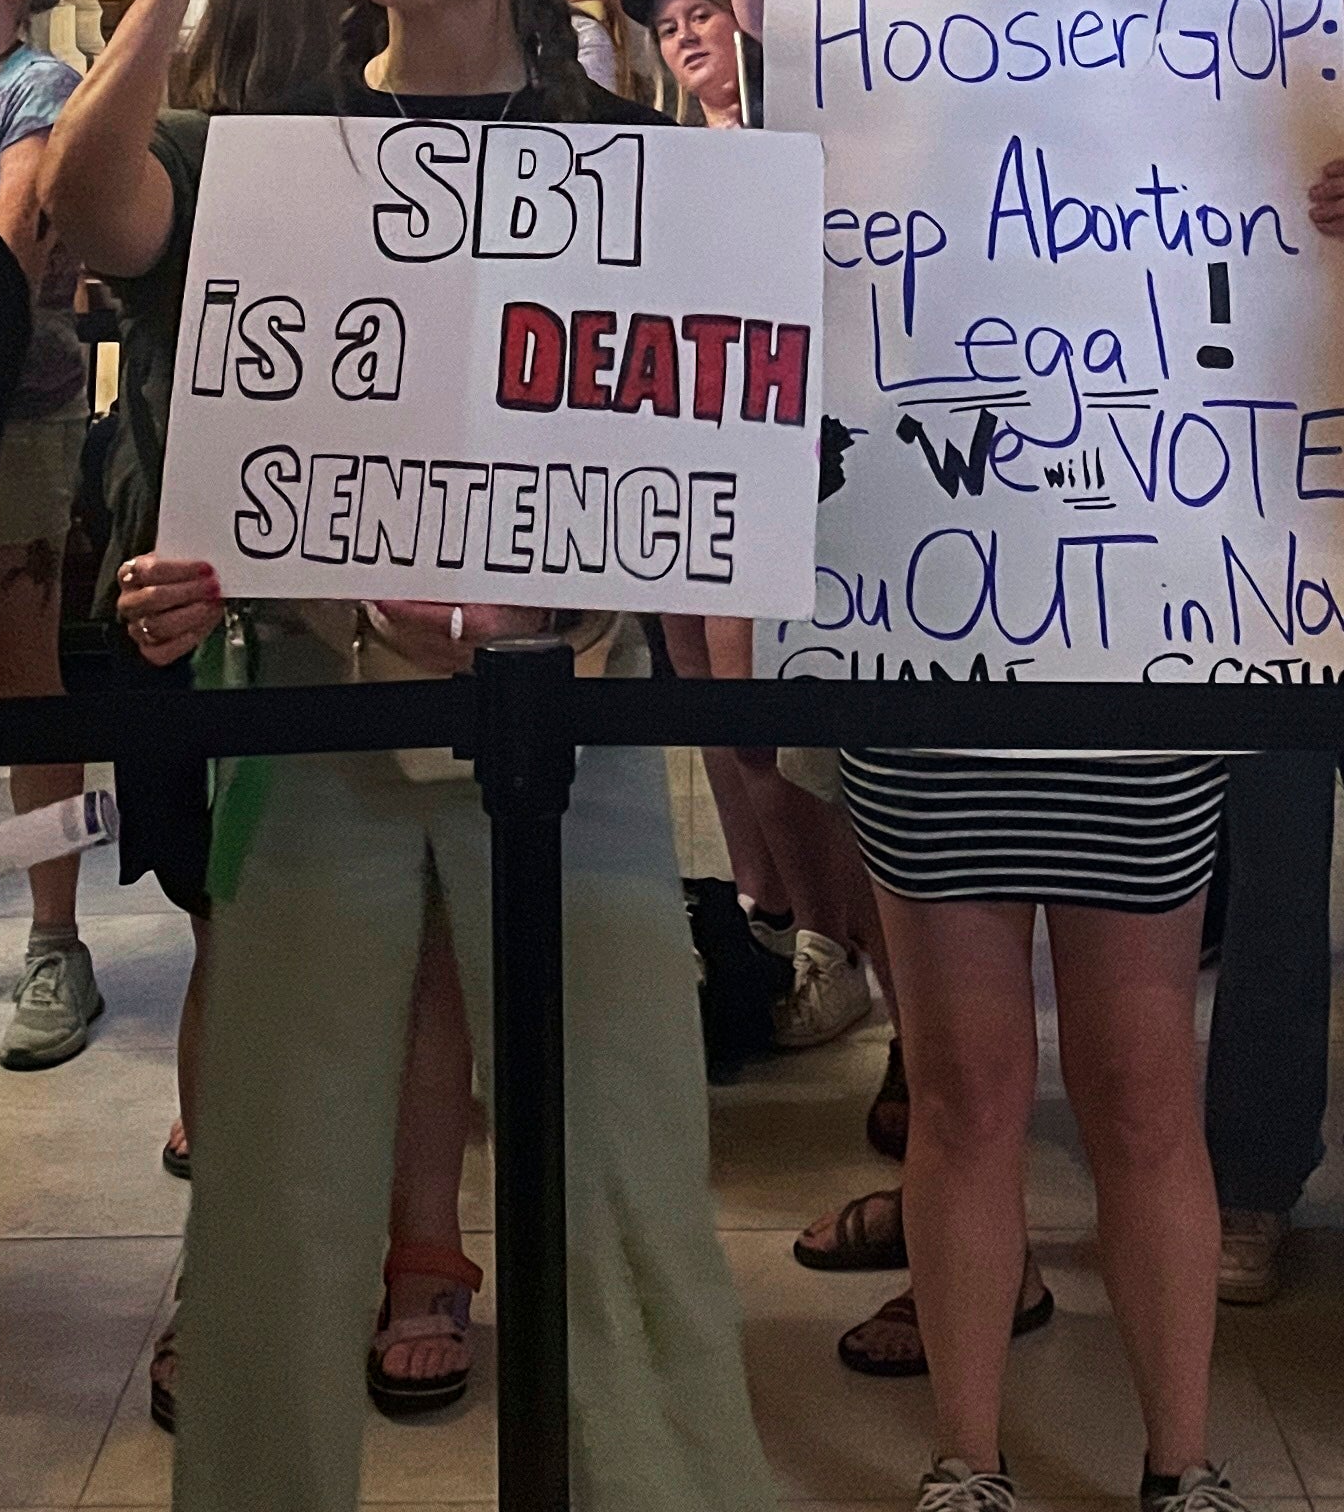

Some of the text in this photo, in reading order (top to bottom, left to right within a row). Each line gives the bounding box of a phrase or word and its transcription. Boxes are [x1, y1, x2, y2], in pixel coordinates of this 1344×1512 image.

[372, 120, 645, 267] SB1
[823, 135, 1299, 337] eep Abortion
[191, 279, 811, 429] is a DEATH
[871, 263, 1235, 448] Legal!
[233, 444, 738, 585] SENTENCE
[895, 409, 1040, 500] We
[1043, 446, 1106, 491] will
[777, 566, 893, 644] ou
[906, 527, 1159, 649] OUT
[1161, 583, 1214, 644] in
